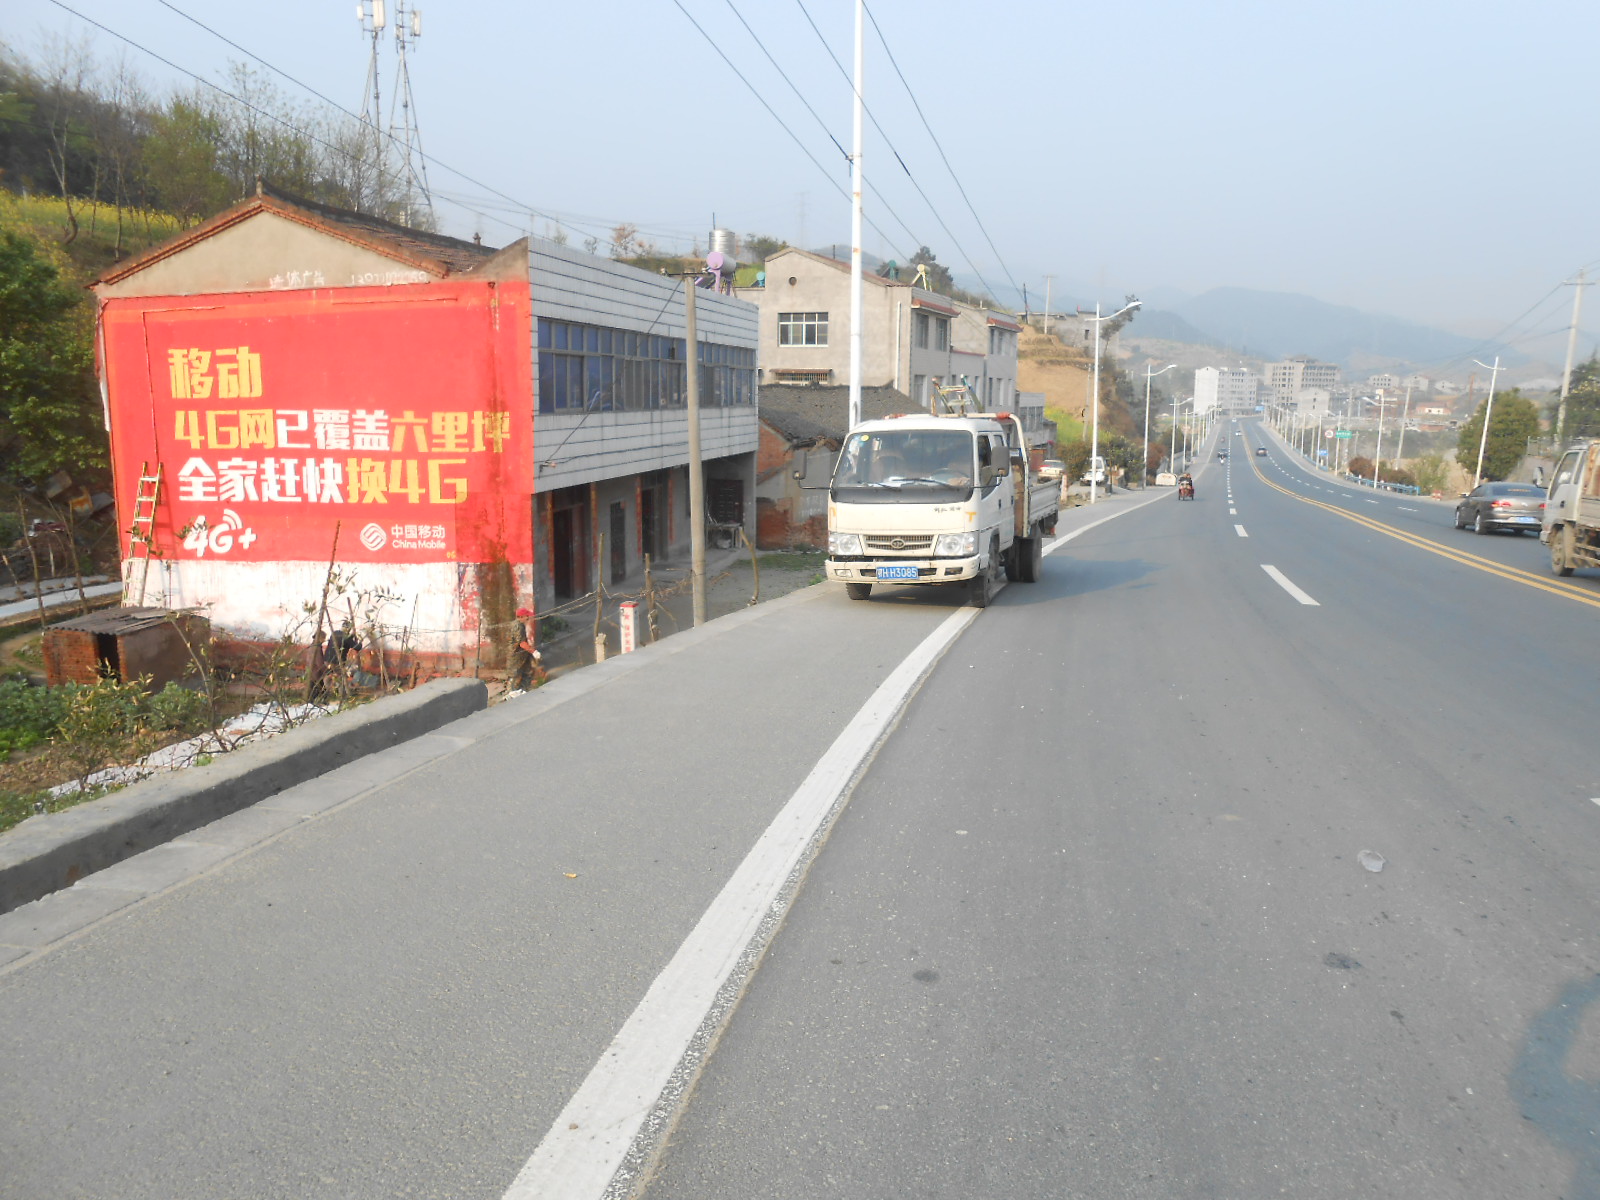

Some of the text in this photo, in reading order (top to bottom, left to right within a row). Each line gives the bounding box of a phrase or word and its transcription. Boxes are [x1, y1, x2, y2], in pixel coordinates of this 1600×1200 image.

[168, 346, 263, 398] 移动
[174, 408, 511, 452] 4G网已覆盖六里坪
[178, 458, 468, 503] 全家赶快换4G
[391, 524, 446, 538] 中国移动
[392, 539, 446, 549] China Mobile
